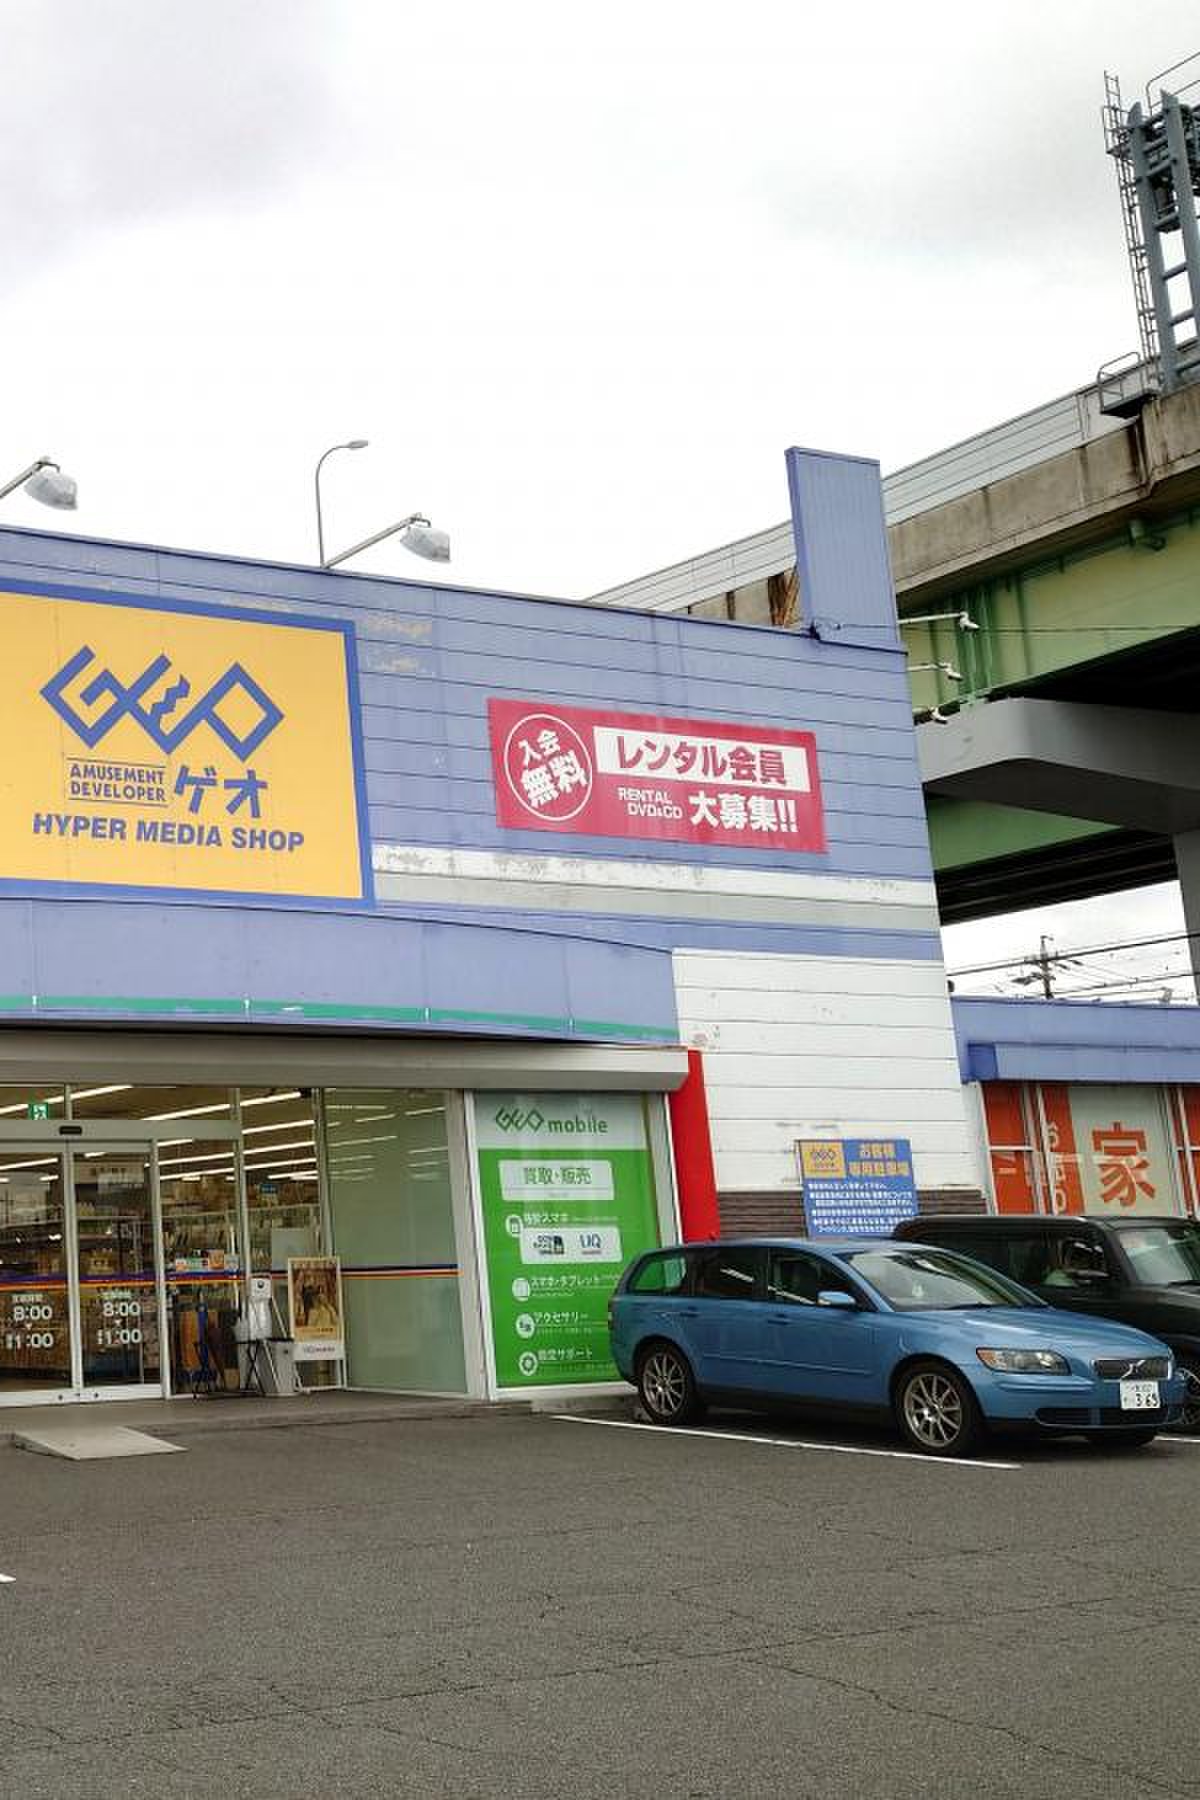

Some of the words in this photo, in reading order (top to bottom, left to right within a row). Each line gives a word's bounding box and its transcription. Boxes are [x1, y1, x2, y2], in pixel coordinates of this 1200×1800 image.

[39, 644, 285, 762] GEO
[518, 730, 559, 766] 入会
[616, 735, 787, 784] レンタル会員
[69, 763, 166, 785] AMUSEMENT
[70, 780, 167, 802] DEVELOPER
[174, 765, 268, 818] ゲオ
[520, 749, 589, 808] 無料
[618, 787, 672, 804] RENTAL
[688, 790, 799, 833] 大募集!!
[32, 812, 128, 841] HYPER
[135, 820, 223, 849] MEDIA
[231, 827, 305, 853] SHOP
[548, 1115, 609, 1134] mobile
[1092, 1121, 1155, 1206] 家
[13, 1304, 53, 1322] 8:00
[102, 1301, 141, 1318] 8:00
